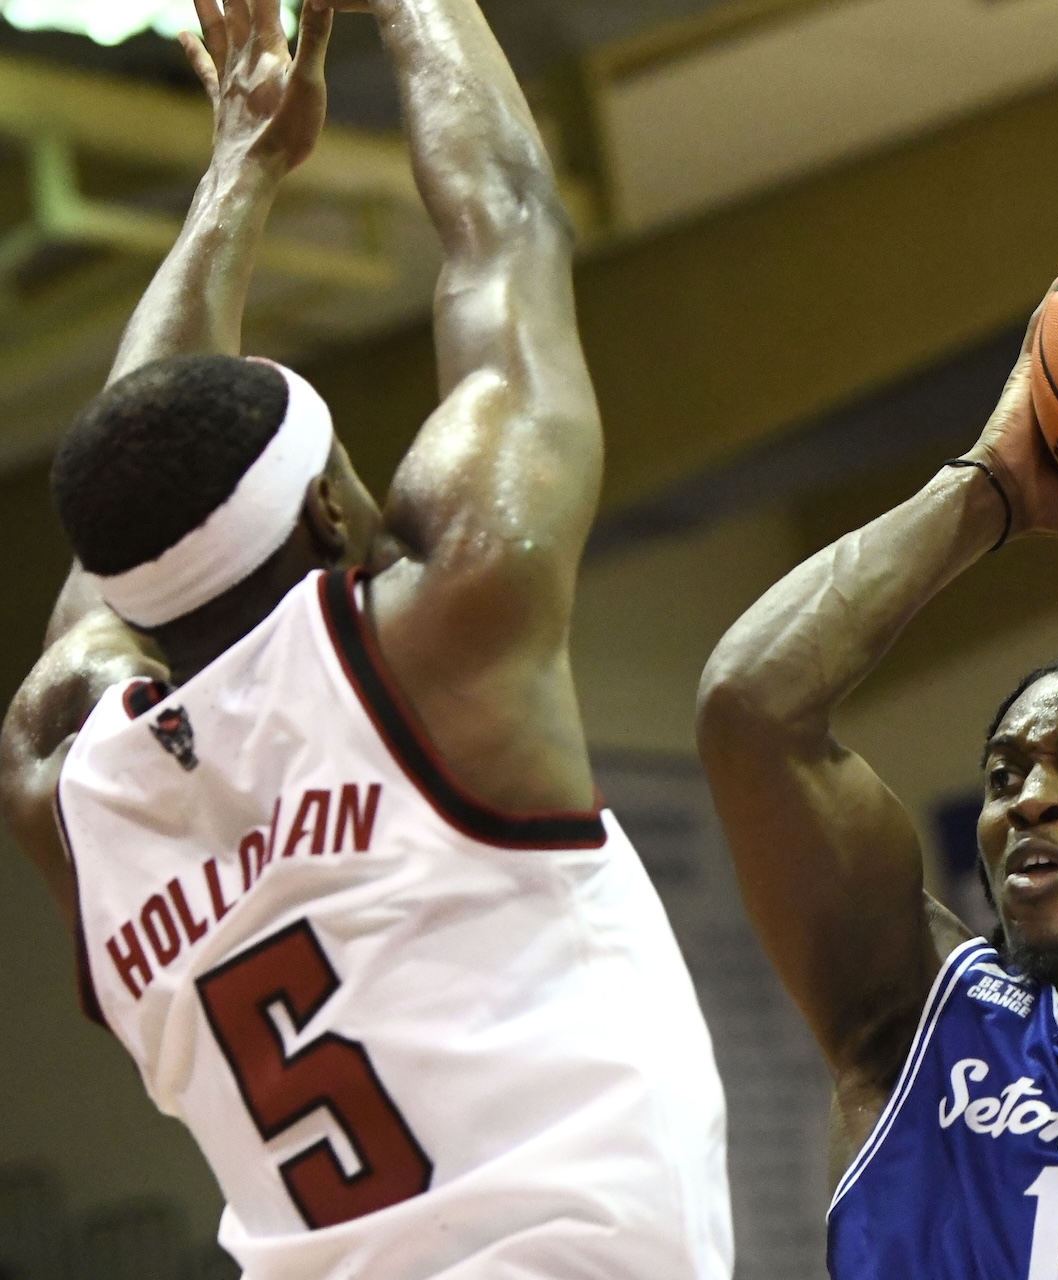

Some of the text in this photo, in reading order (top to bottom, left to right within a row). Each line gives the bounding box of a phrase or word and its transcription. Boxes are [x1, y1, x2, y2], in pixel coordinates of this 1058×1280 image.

[105, 783, 382, 1002] HOLLOAN
[966, 984, 1032, 1019] CHANGE
[978, 975, 1035, 1007] BE THE
[195, 917, 434, 1231] 5
